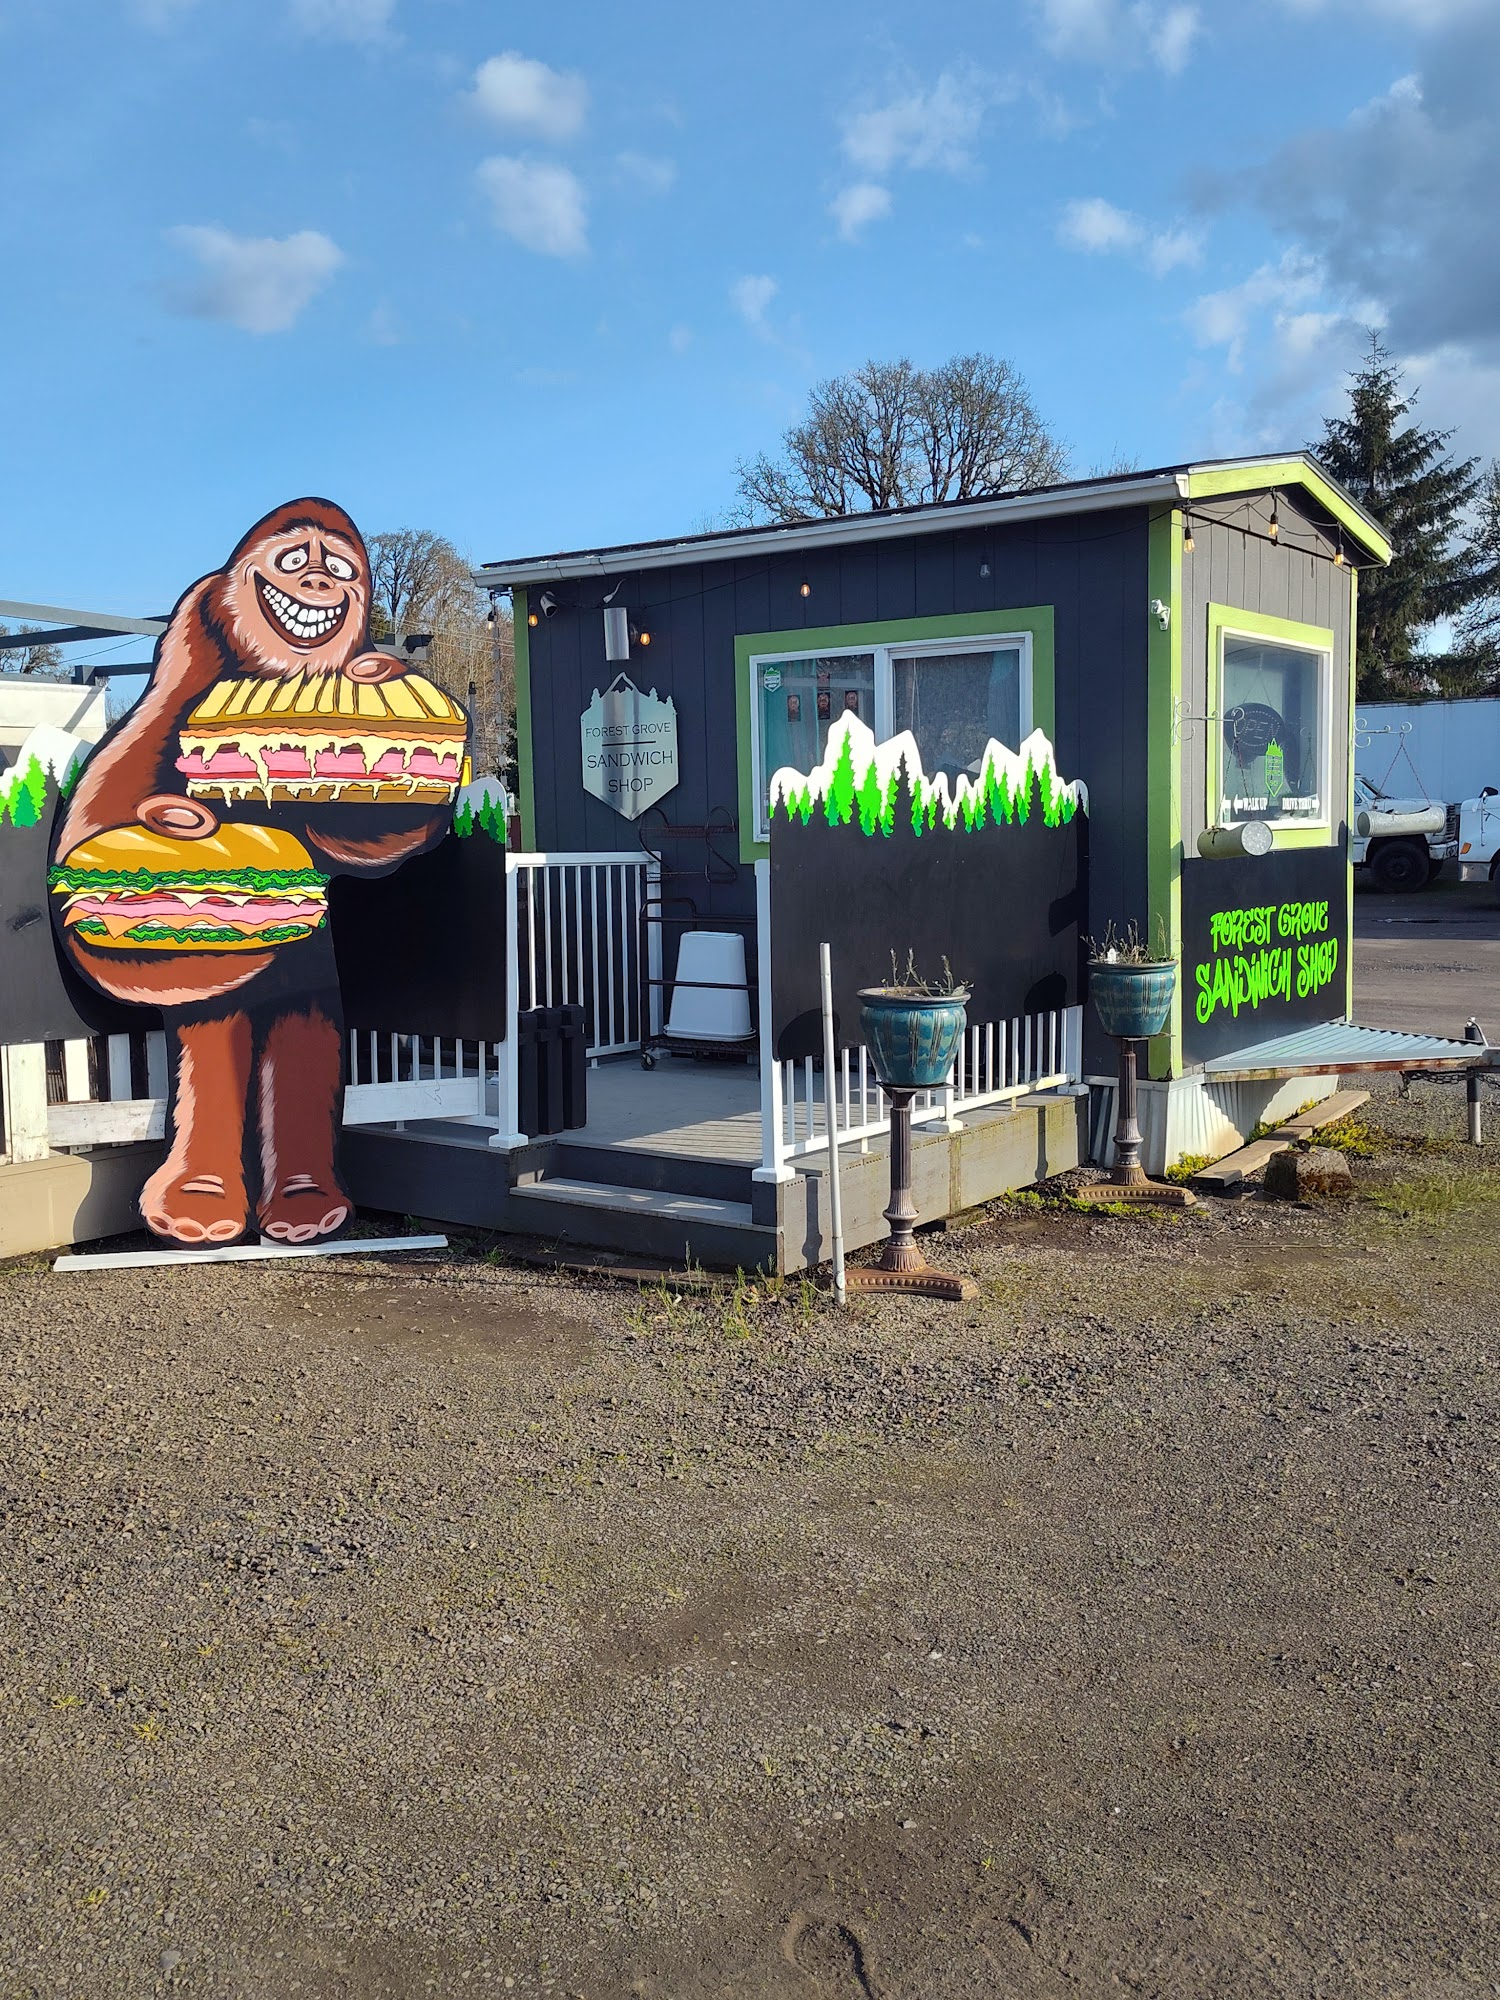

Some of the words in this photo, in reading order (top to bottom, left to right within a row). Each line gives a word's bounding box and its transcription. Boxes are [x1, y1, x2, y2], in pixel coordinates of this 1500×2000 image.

[585, 725, 630, 738] FOREST
[632, 722, 671, 735] GROVE
[587, 750, 673, 769] SANDWICH
[608, 777, 654, 793] SHOP
[1210, 906, 1277, 953] FOREST
[1277, 901, 1329, 941] GROVE
[1195, 947, 1293, 1024] SANDWICH
[1297, 937, 1338, 998] SHOP
